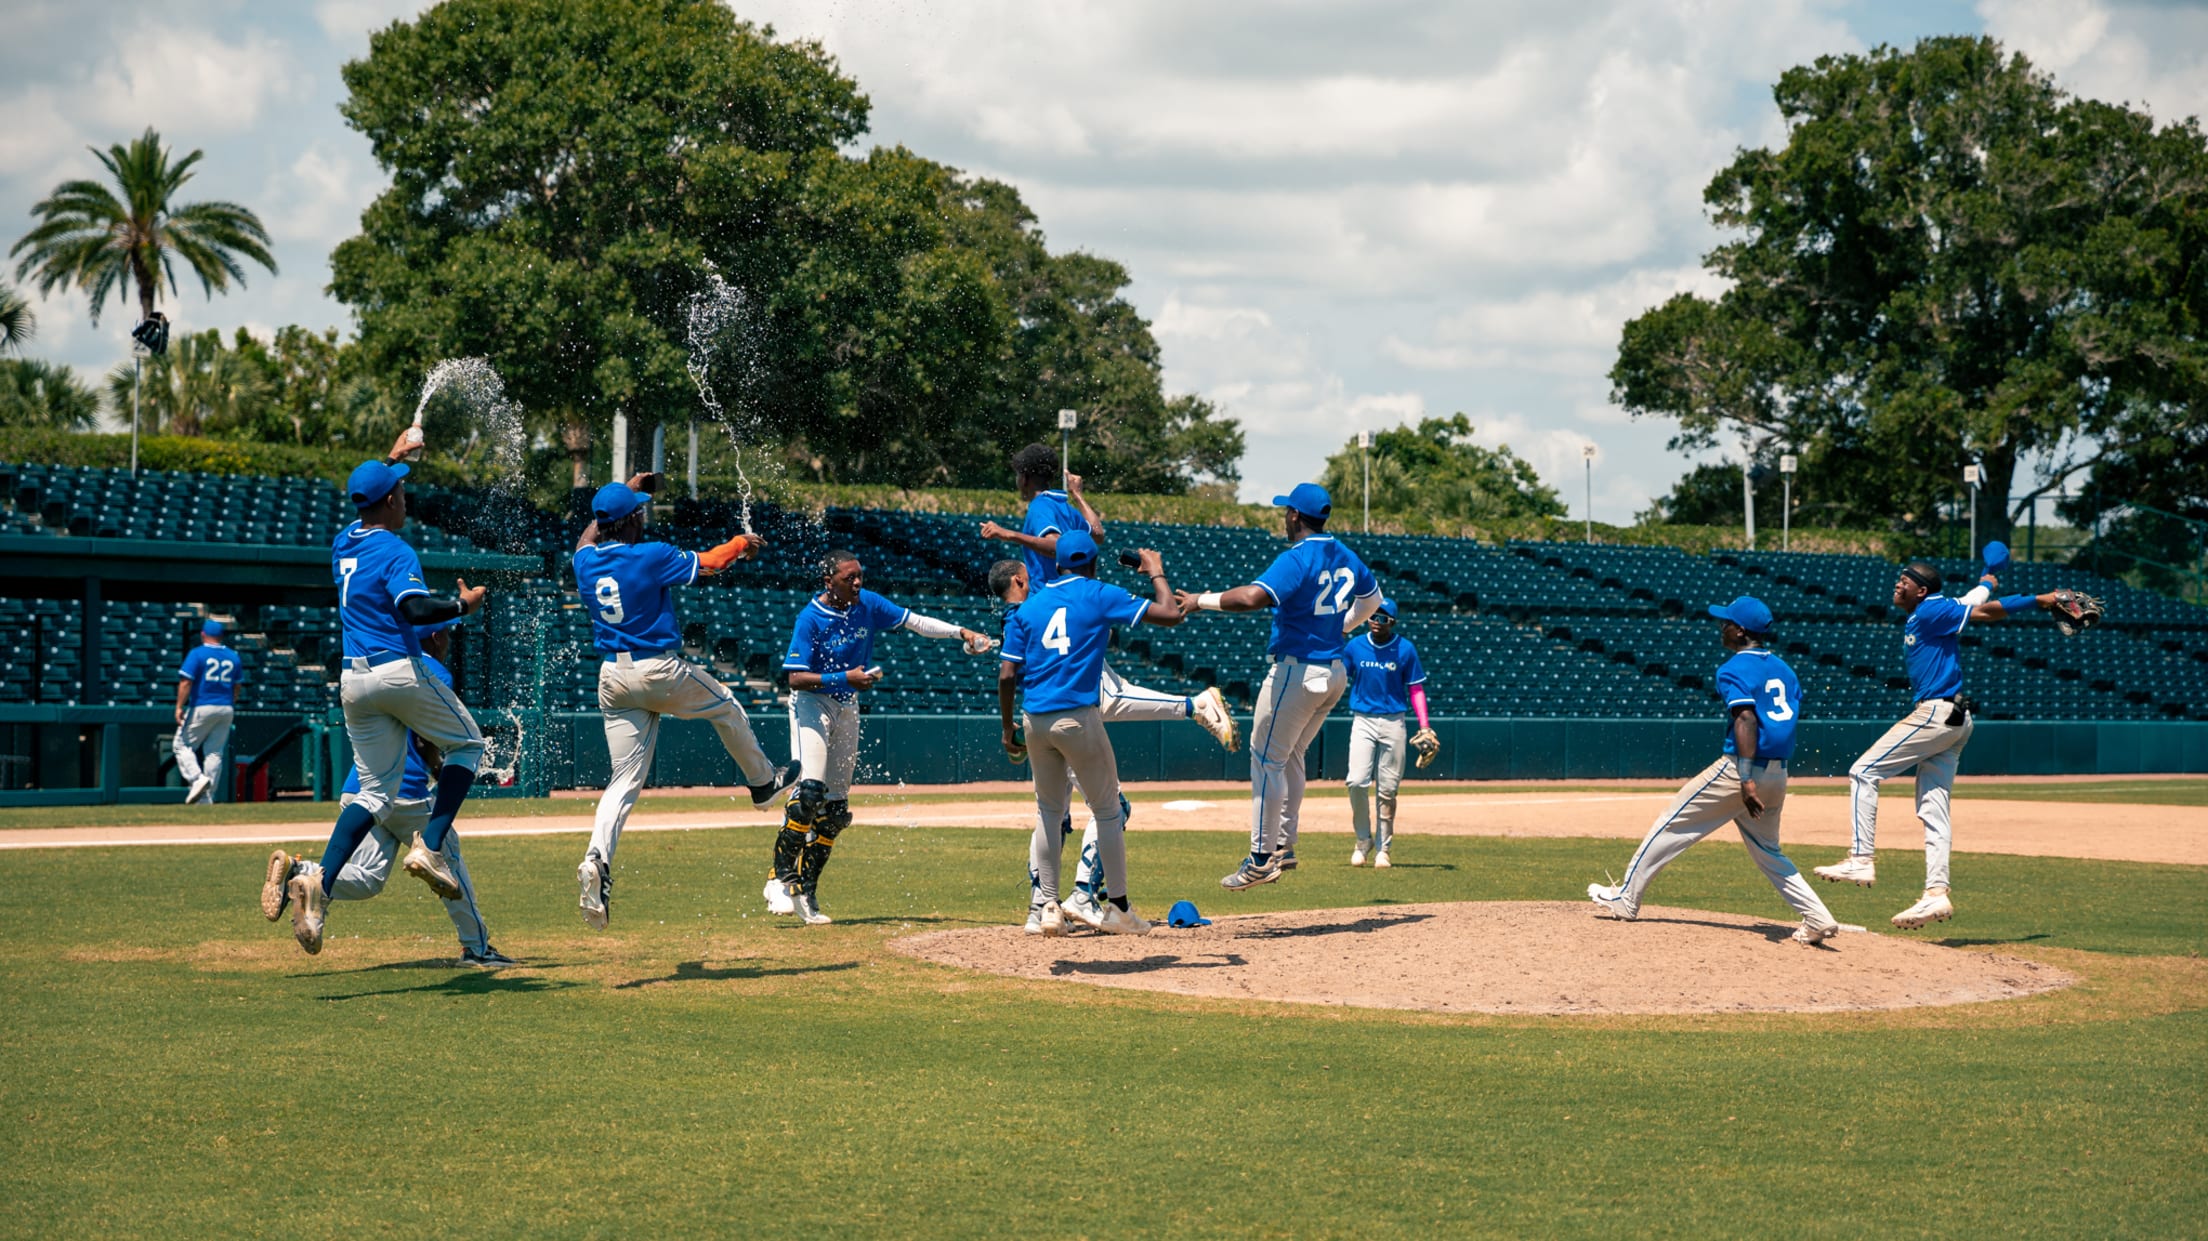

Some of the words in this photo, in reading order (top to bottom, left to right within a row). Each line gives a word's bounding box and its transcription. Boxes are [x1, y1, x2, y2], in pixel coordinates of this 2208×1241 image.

[339, 558, 357, 607] 7
[595, 576, 625, 624] 9
[1313, 566, 1355, 616] 22
[1041, 606, 1071, 656] 4
[205, 657, 234, 683] 22
[1764, 678, 1794, 722] 3
